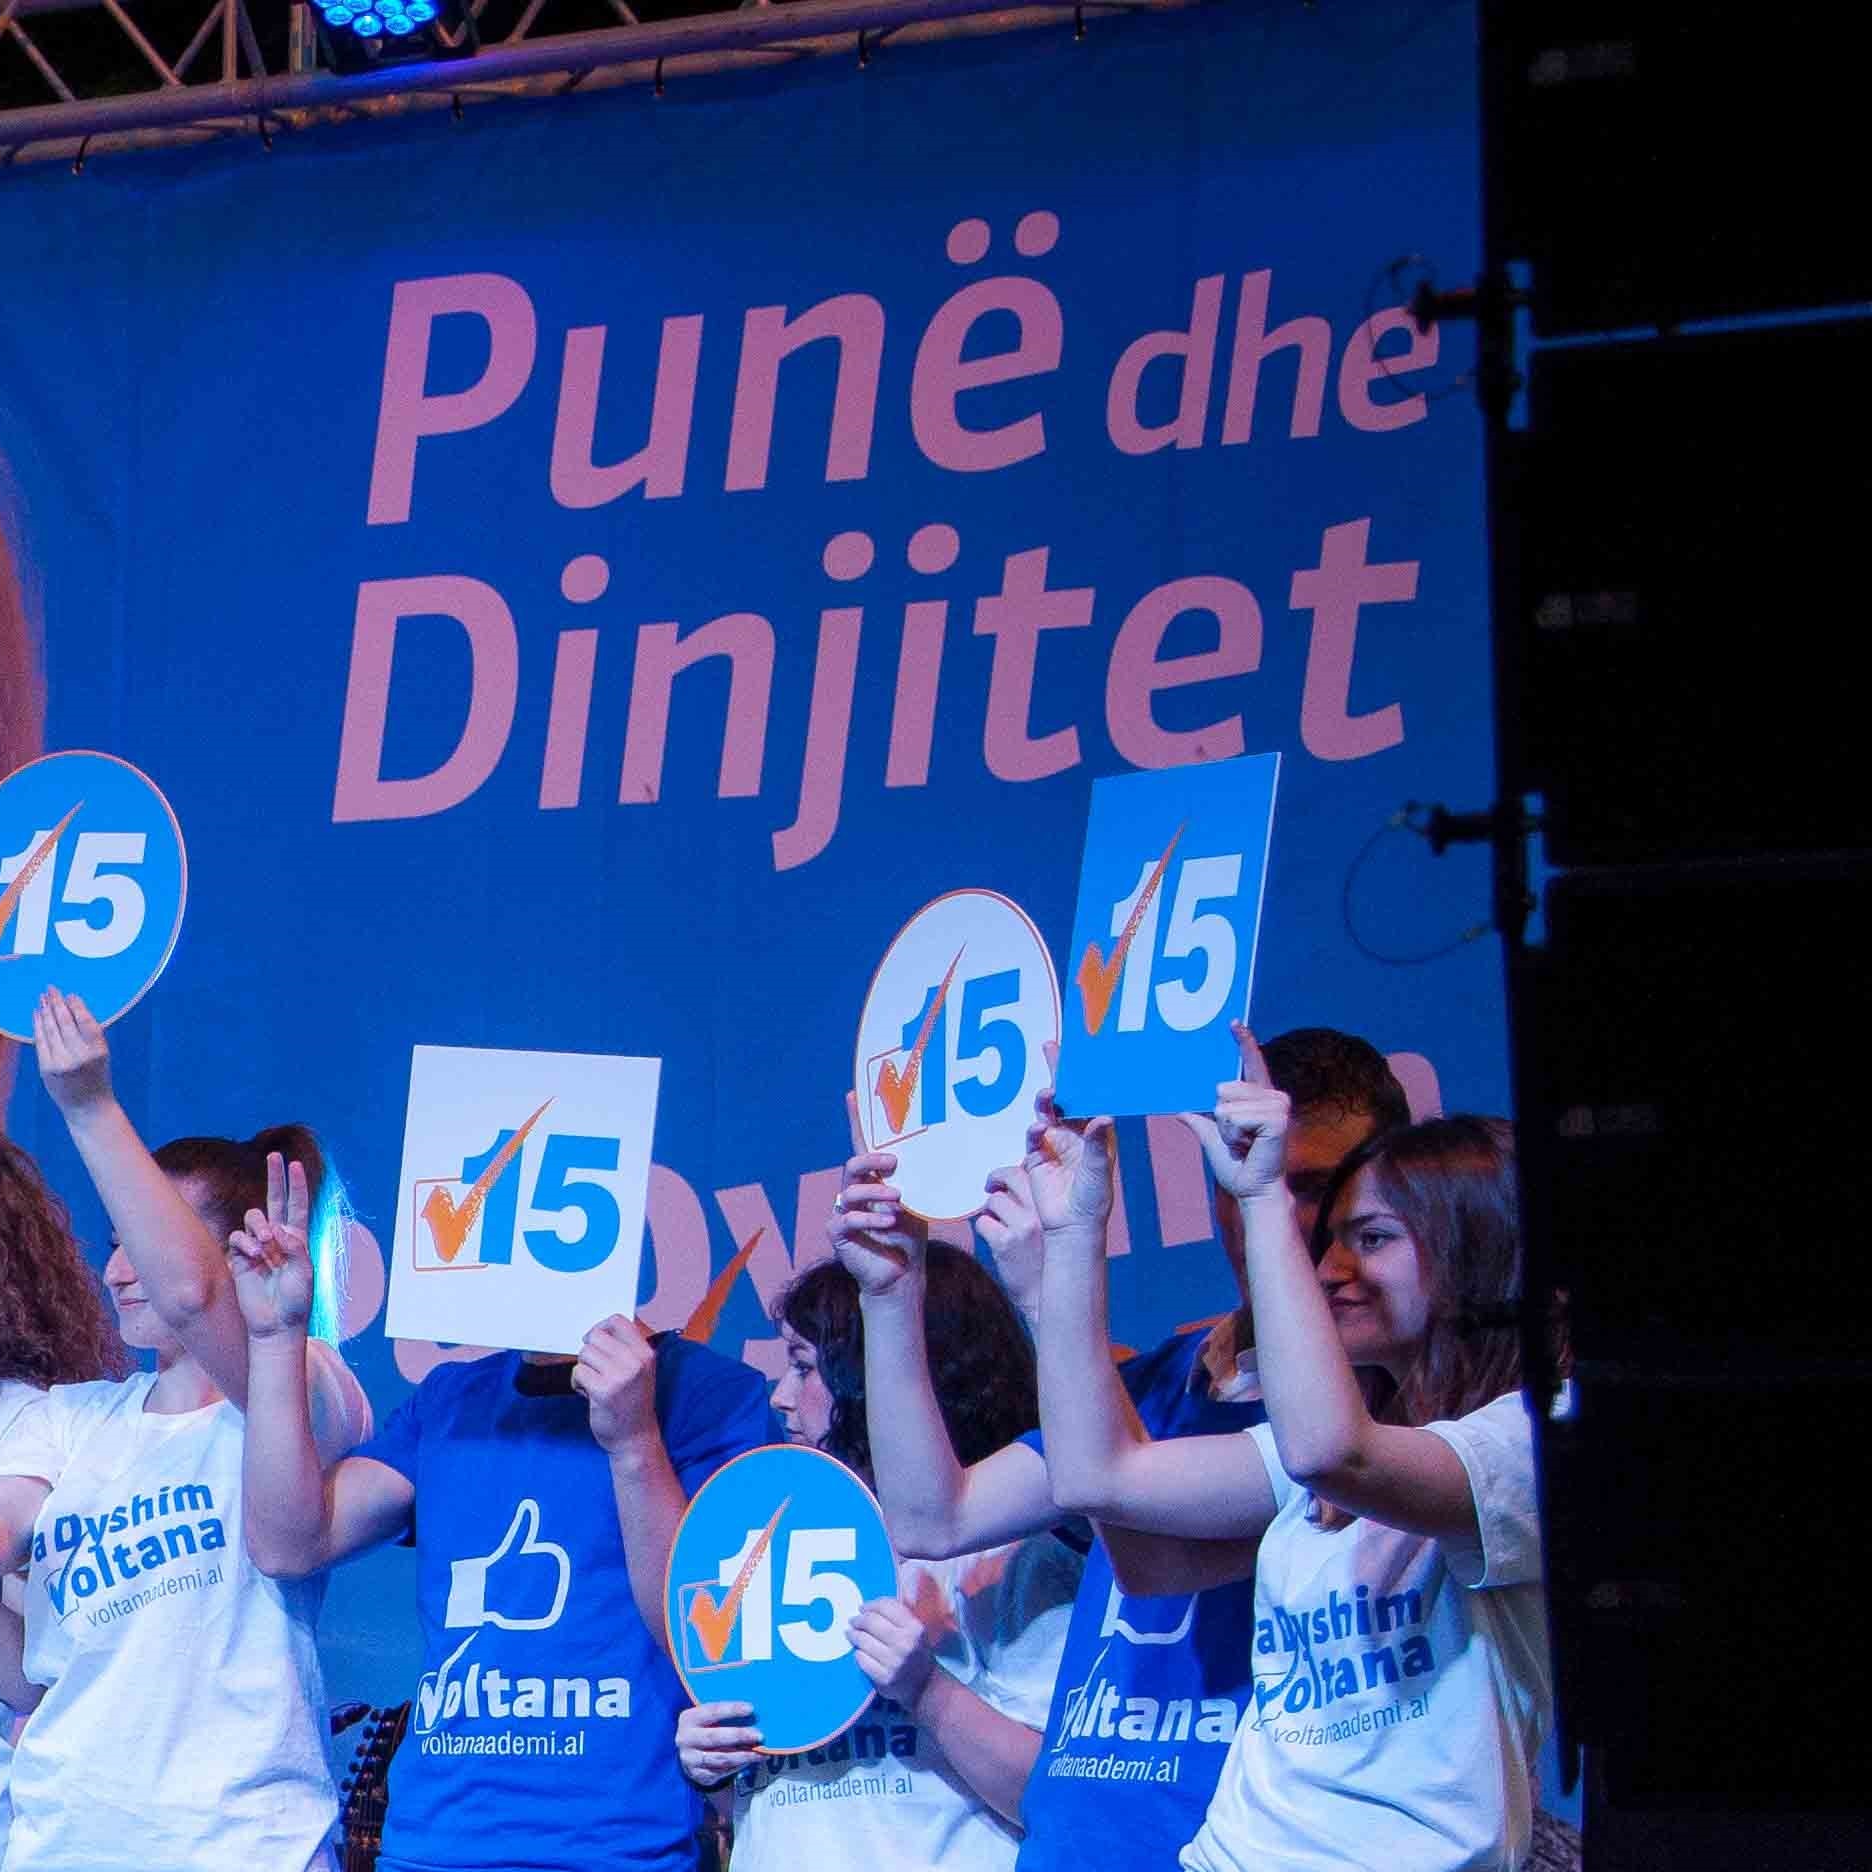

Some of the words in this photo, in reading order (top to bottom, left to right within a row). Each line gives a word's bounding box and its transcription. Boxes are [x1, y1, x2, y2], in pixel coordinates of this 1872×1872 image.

[364, 209, 1066, 528] Punë
[1104, 268, 1442, 458] dhe
[330, 514, 1421, 873] Dinjitet
[1108, 852, 1244, 1034] 15
[898, 967, 1031, 1129] 15
[458, 1126, 623, 1275] 15
[53, 1483, 214, 1553] Dyshim
[716, 1526, 863, 1665] 15
[1272, 1584, 1423, 1661] Dyshim
[421, 1730, 585, 1757] voltanaademi.al
[769, 1772, 913, 1809] voltanaademi.al
